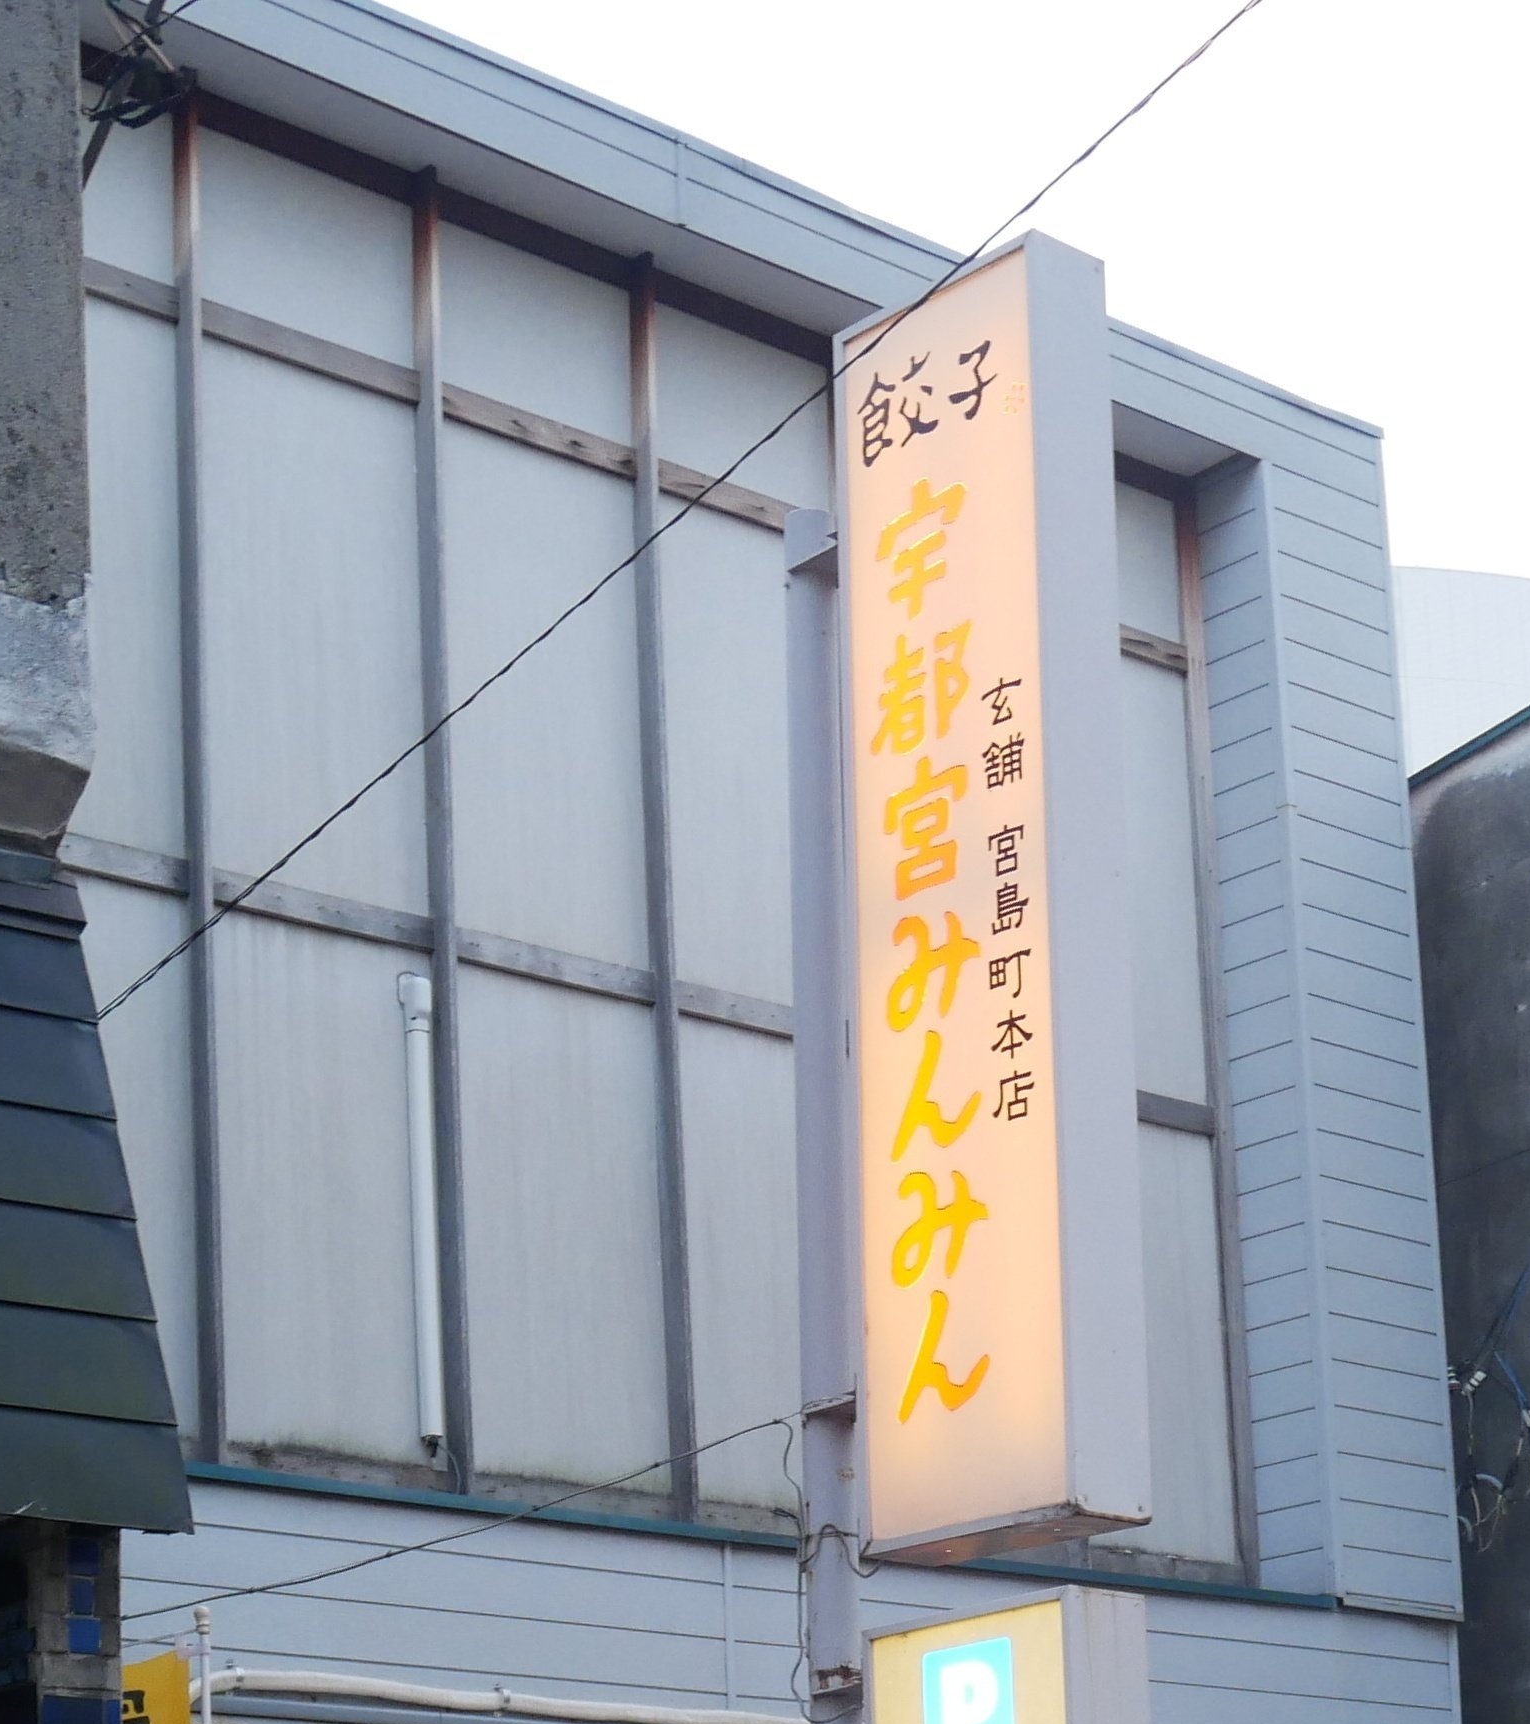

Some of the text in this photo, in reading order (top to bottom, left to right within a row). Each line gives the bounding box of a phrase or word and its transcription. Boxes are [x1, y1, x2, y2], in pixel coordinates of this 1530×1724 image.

[857, 340, 997, 467] 餃子
[871, 476, 989, 1424] 宇都宮みんみん
[987, 824, 1035, 1122] 宮島町本店
